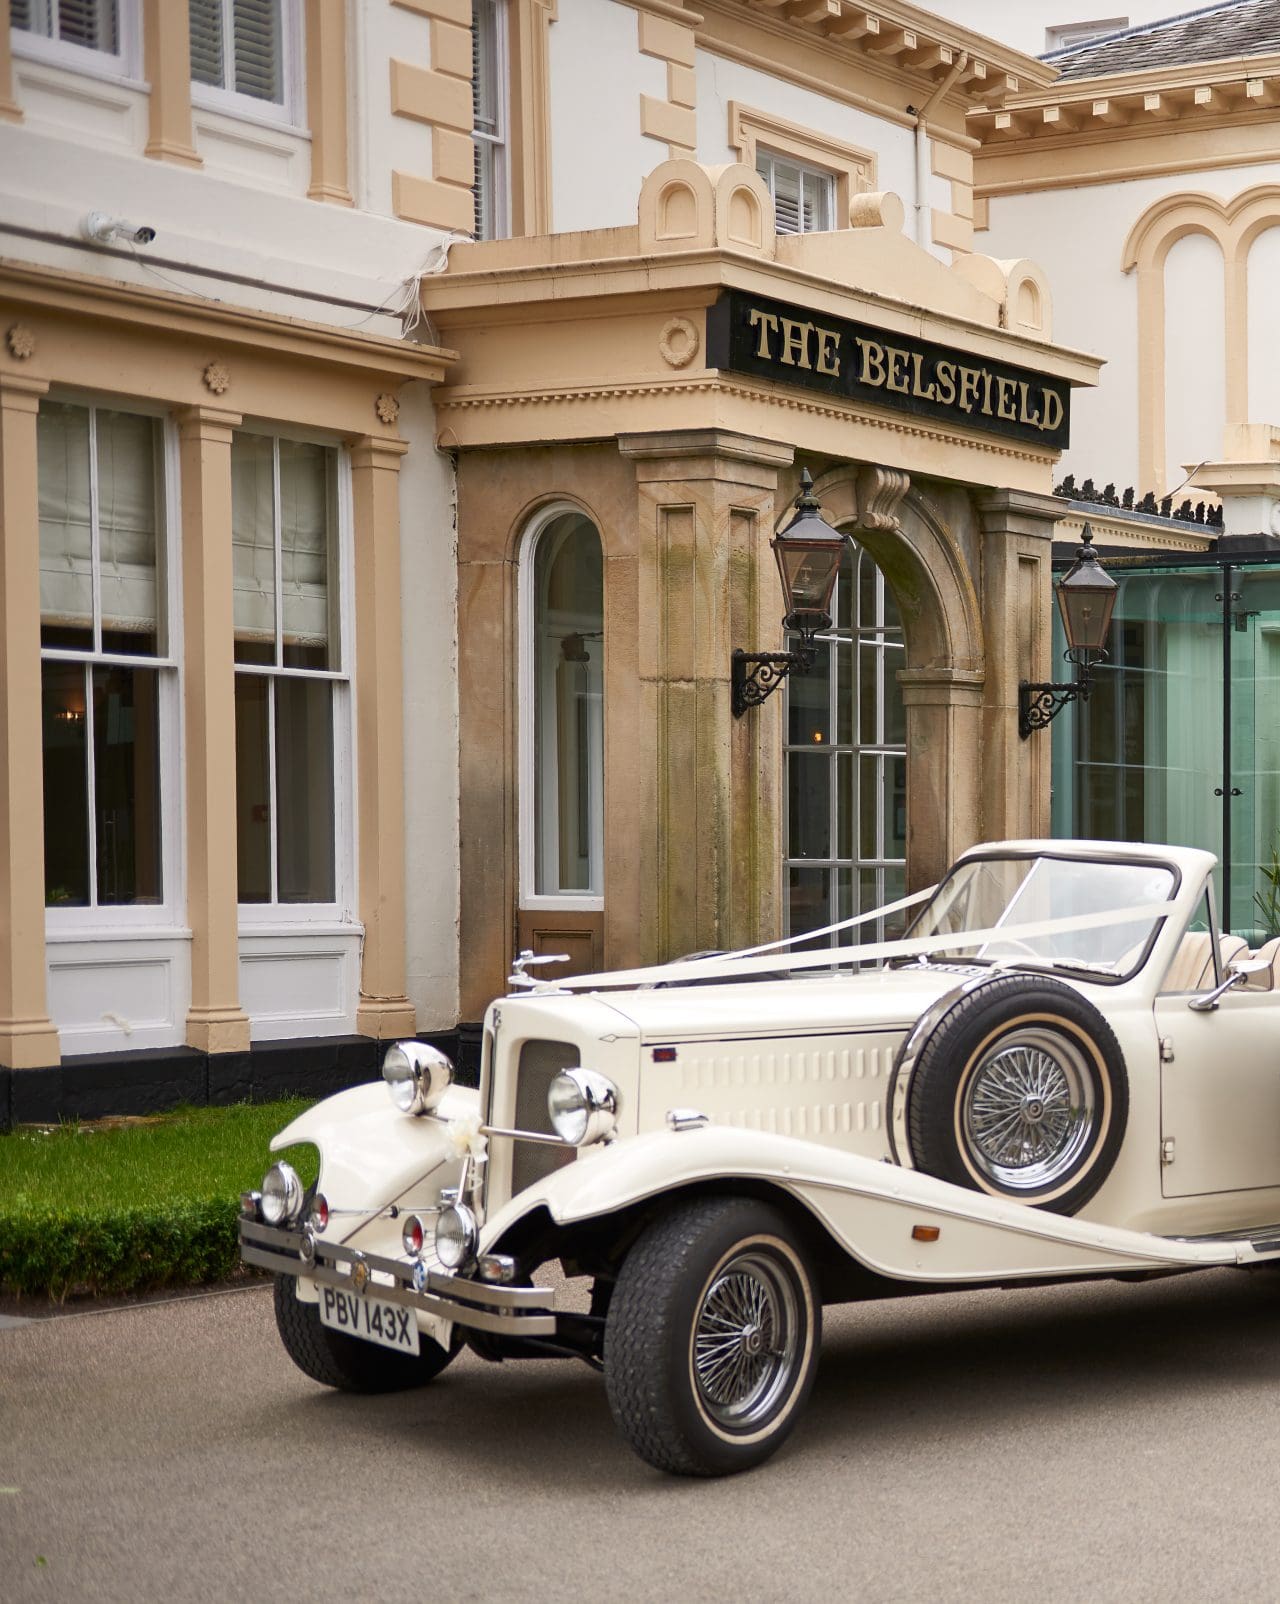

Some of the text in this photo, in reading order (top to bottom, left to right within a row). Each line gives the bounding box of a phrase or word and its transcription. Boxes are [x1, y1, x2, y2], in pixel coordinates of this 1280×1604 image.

[750, 308, 1064, 432] THE BELSFIELD
[324, 1287, 412, 1346] PBV 143X
